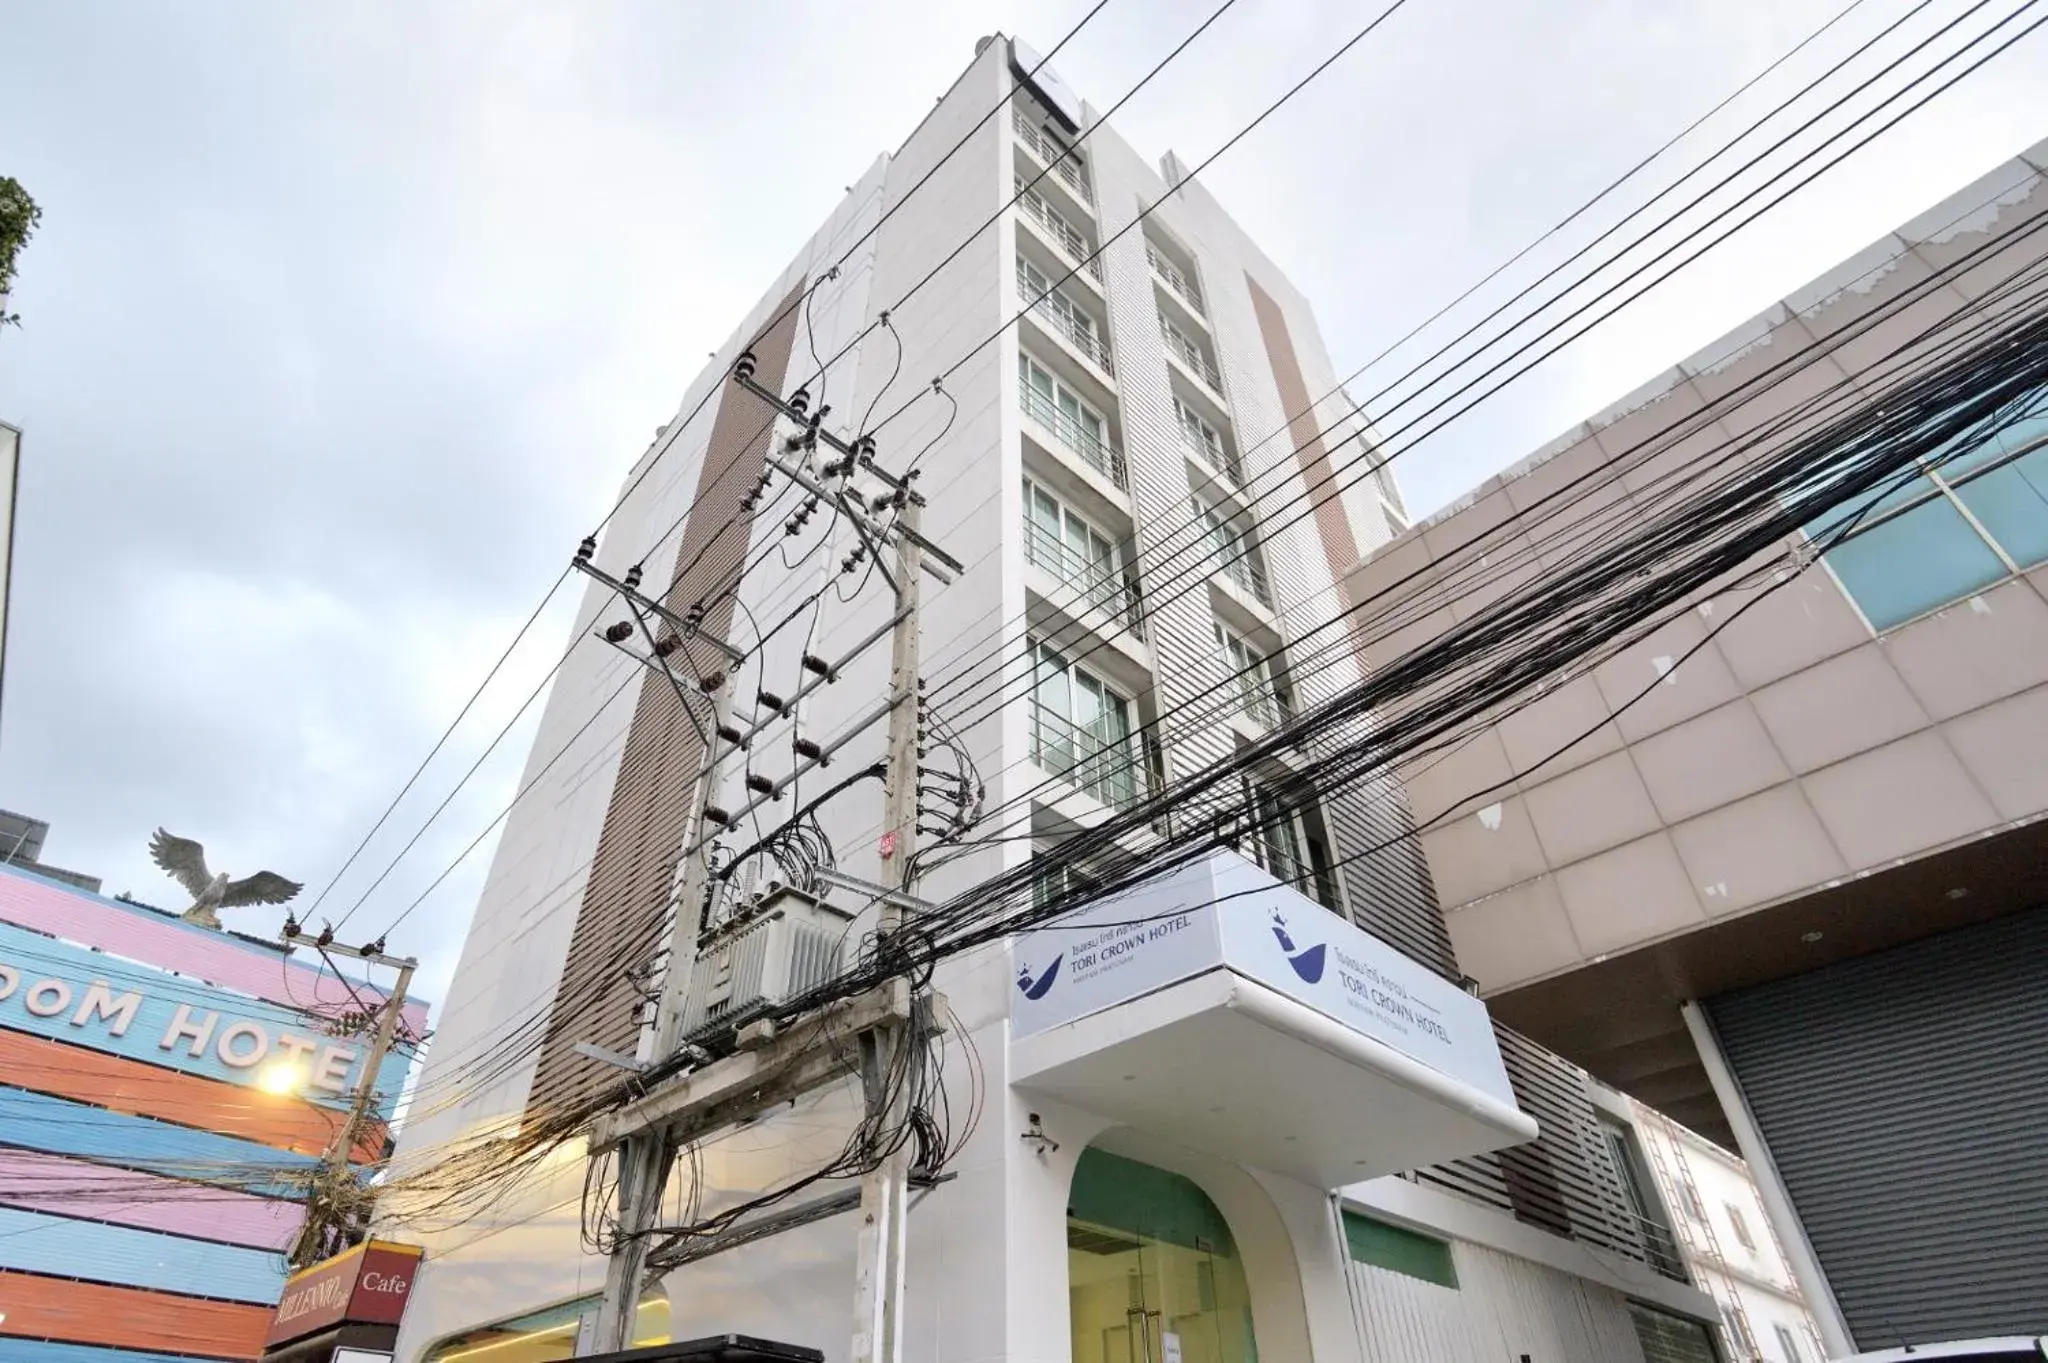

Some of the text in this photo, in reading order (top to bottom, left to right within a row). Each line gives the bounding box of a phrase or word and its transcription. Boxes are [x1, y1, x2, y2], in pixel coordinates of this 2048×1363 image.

[1071, 953, 1097, 973] TORI
[1101, 933, 1145, 961] CROWN
[1149, 915, 1191, 941] HOTEL
[1338, 969, 1369, 1001] TORI
[1371, 988, 1415, 1024] CROWN
[1415, 1012, 1452, 1045] HOTEL
[159, 1003, 368, 1094] HOTE
[362, 1271, 407, 1294] Cafe
